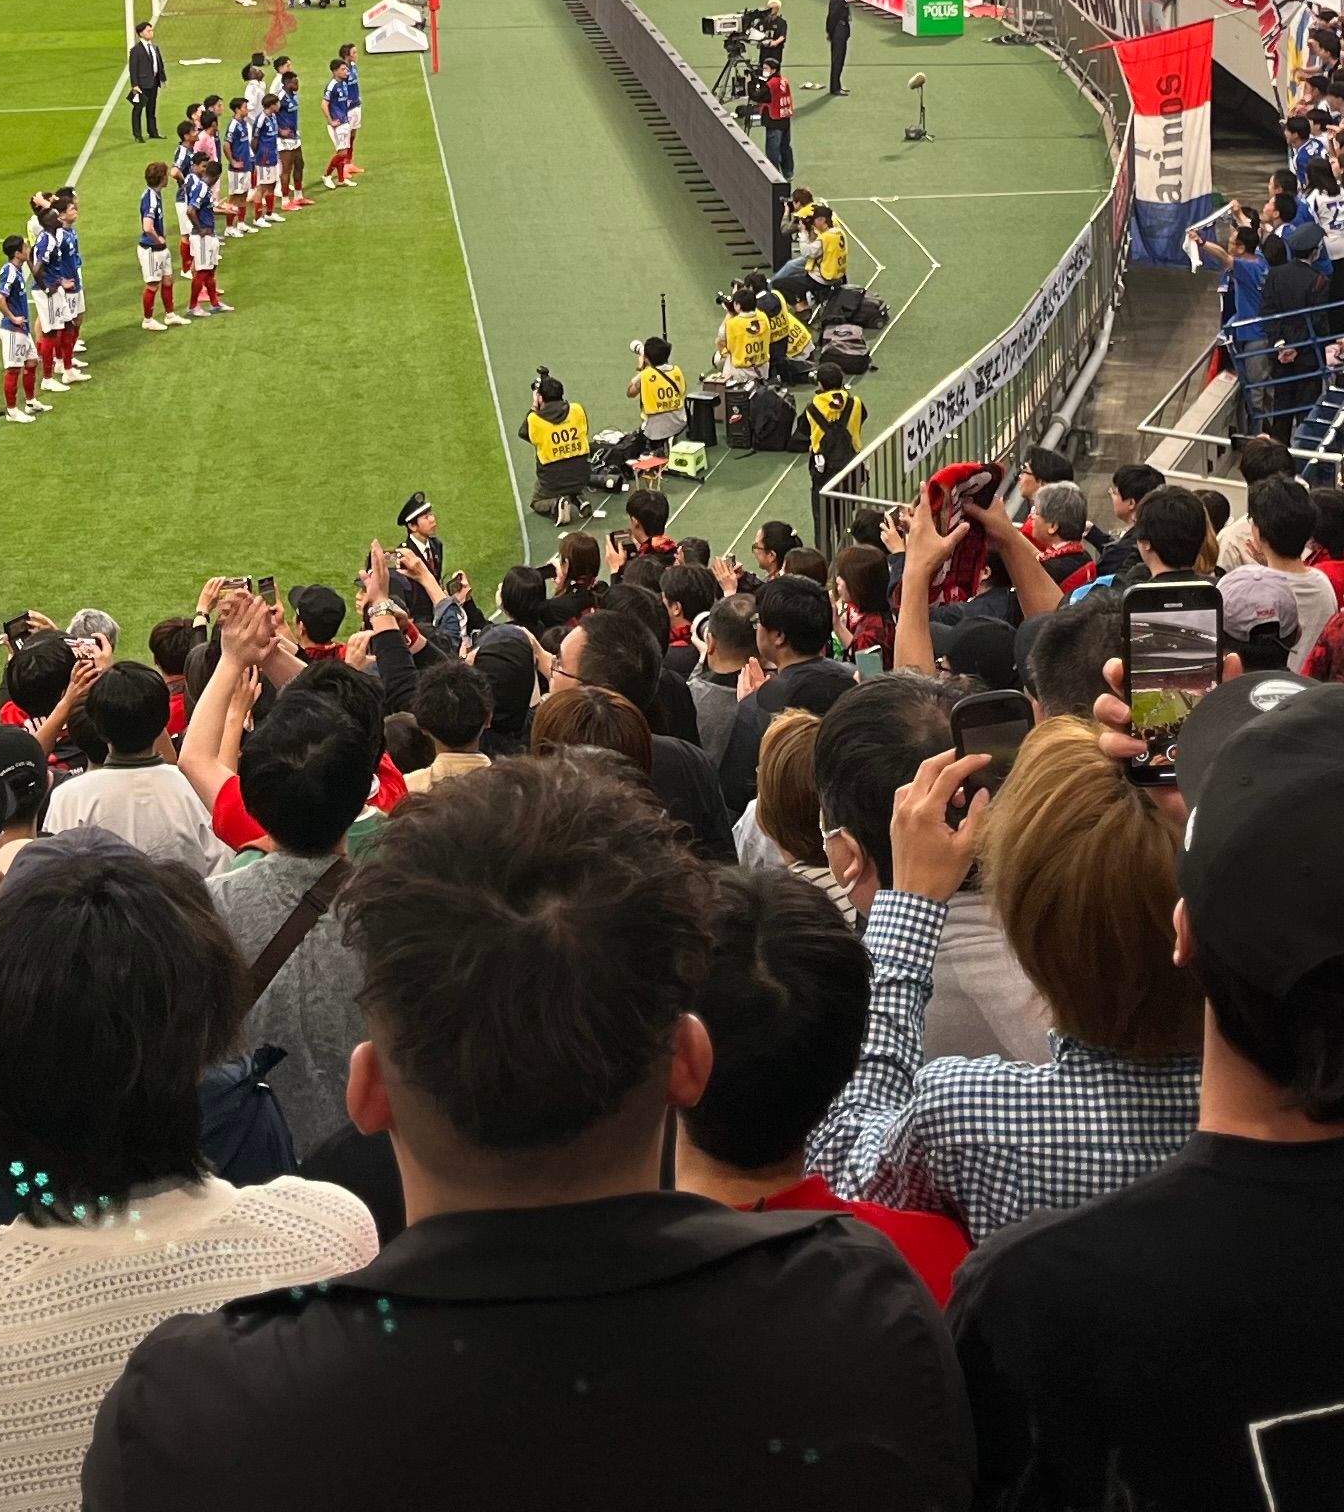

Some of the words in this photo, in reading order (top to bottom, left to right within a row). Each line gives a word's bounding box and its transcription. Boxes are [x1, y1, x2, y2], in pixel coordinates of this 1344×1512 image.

[923, 4, 959, 18] POLUS
[15, 344, 27, 357] 20
[745, 341, 764, 354] 001
[551, 427, 579, 445] 002
[552, 441, 582, 456] PRESS
